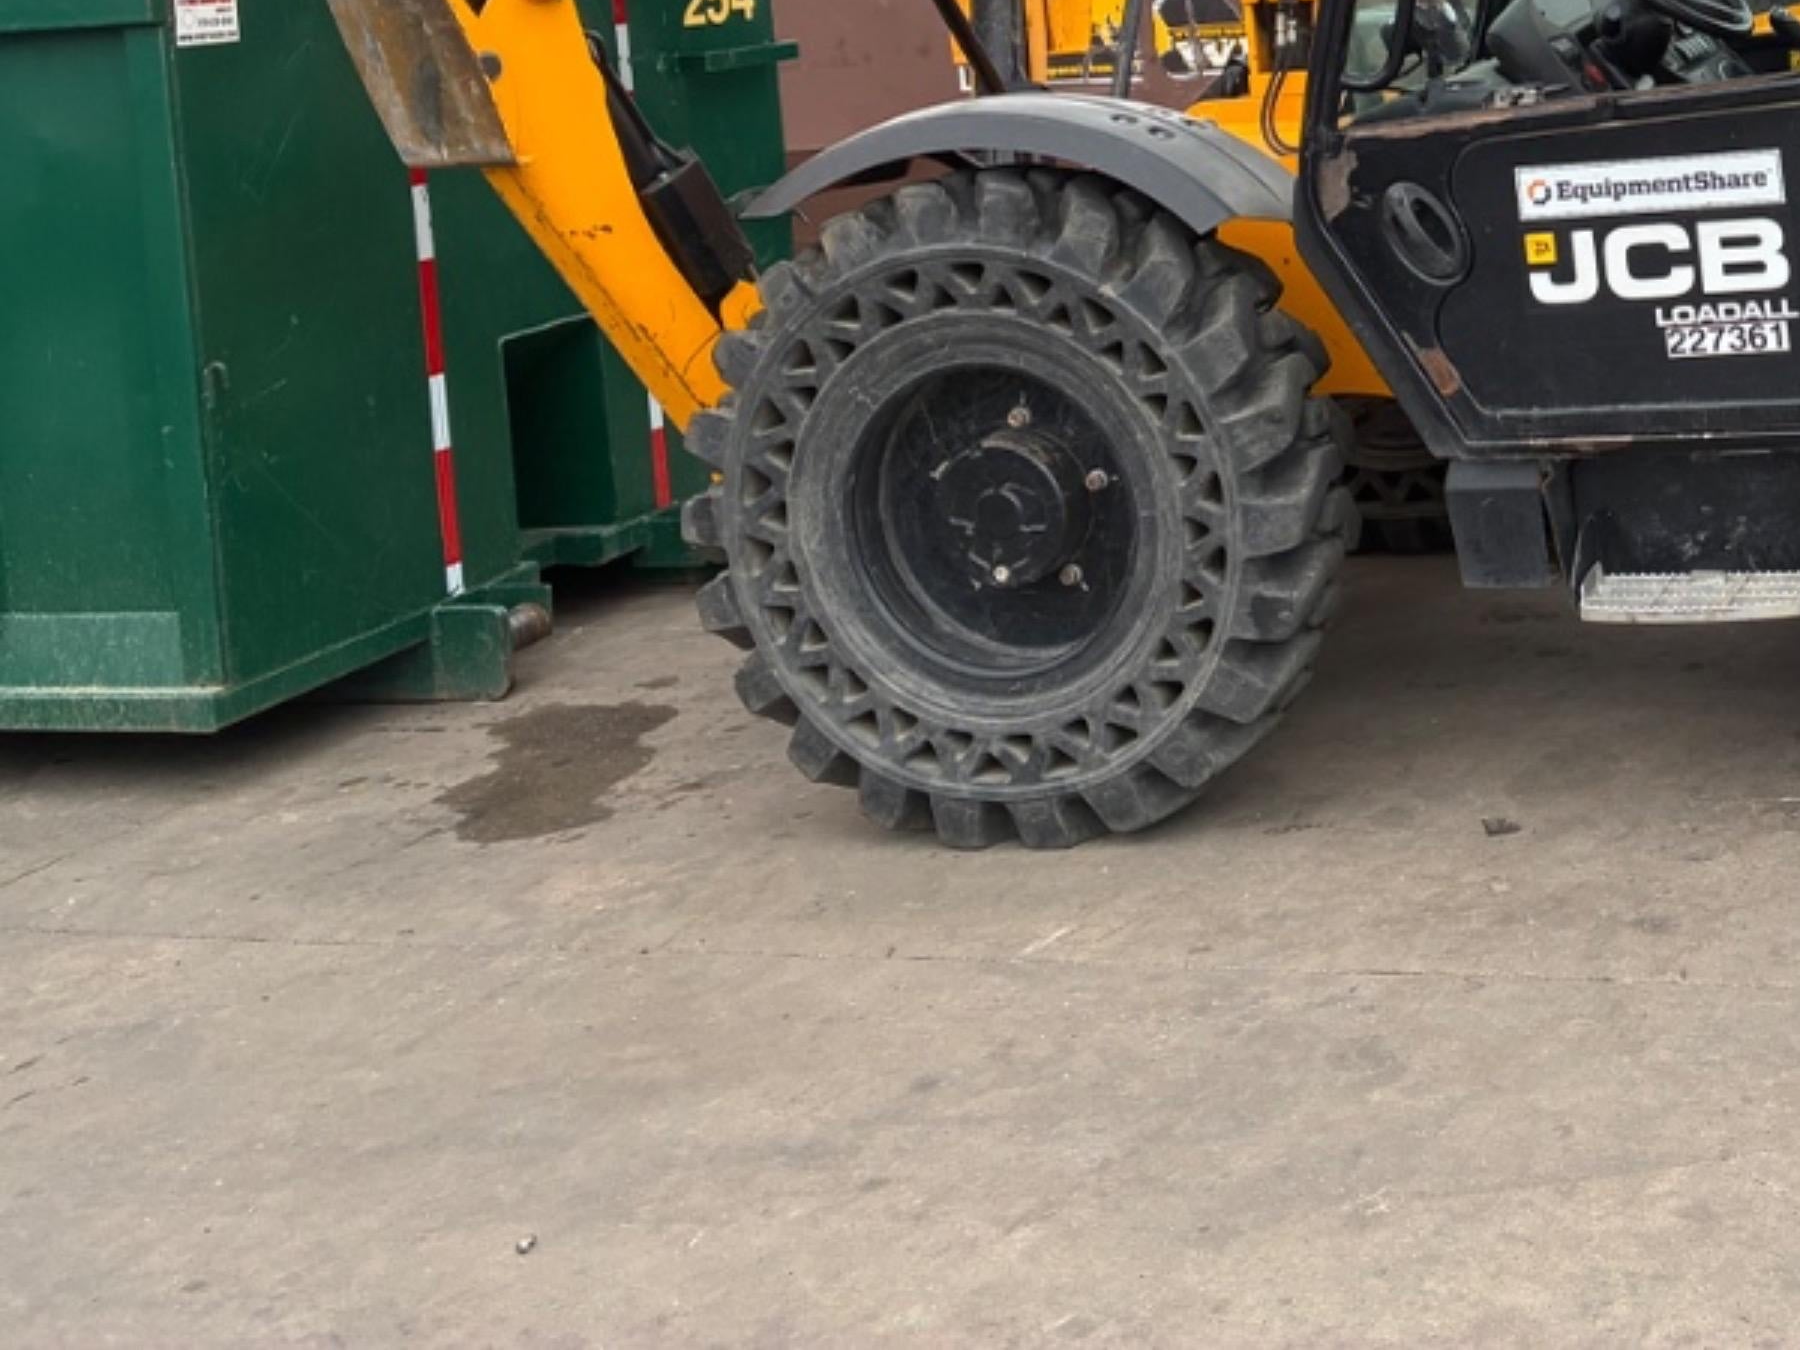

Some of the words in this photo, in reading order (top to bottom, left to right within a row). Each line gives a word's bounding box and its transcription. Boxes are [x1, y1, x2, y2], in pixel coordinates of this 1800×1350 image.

[1556, 169, 1769, 202] EquipmentShare
[1528, 217, 1791, 305] JCB
[1655, 298, 1800, 328] LOADALL
[1667, 323, 1786, 356] 227361
